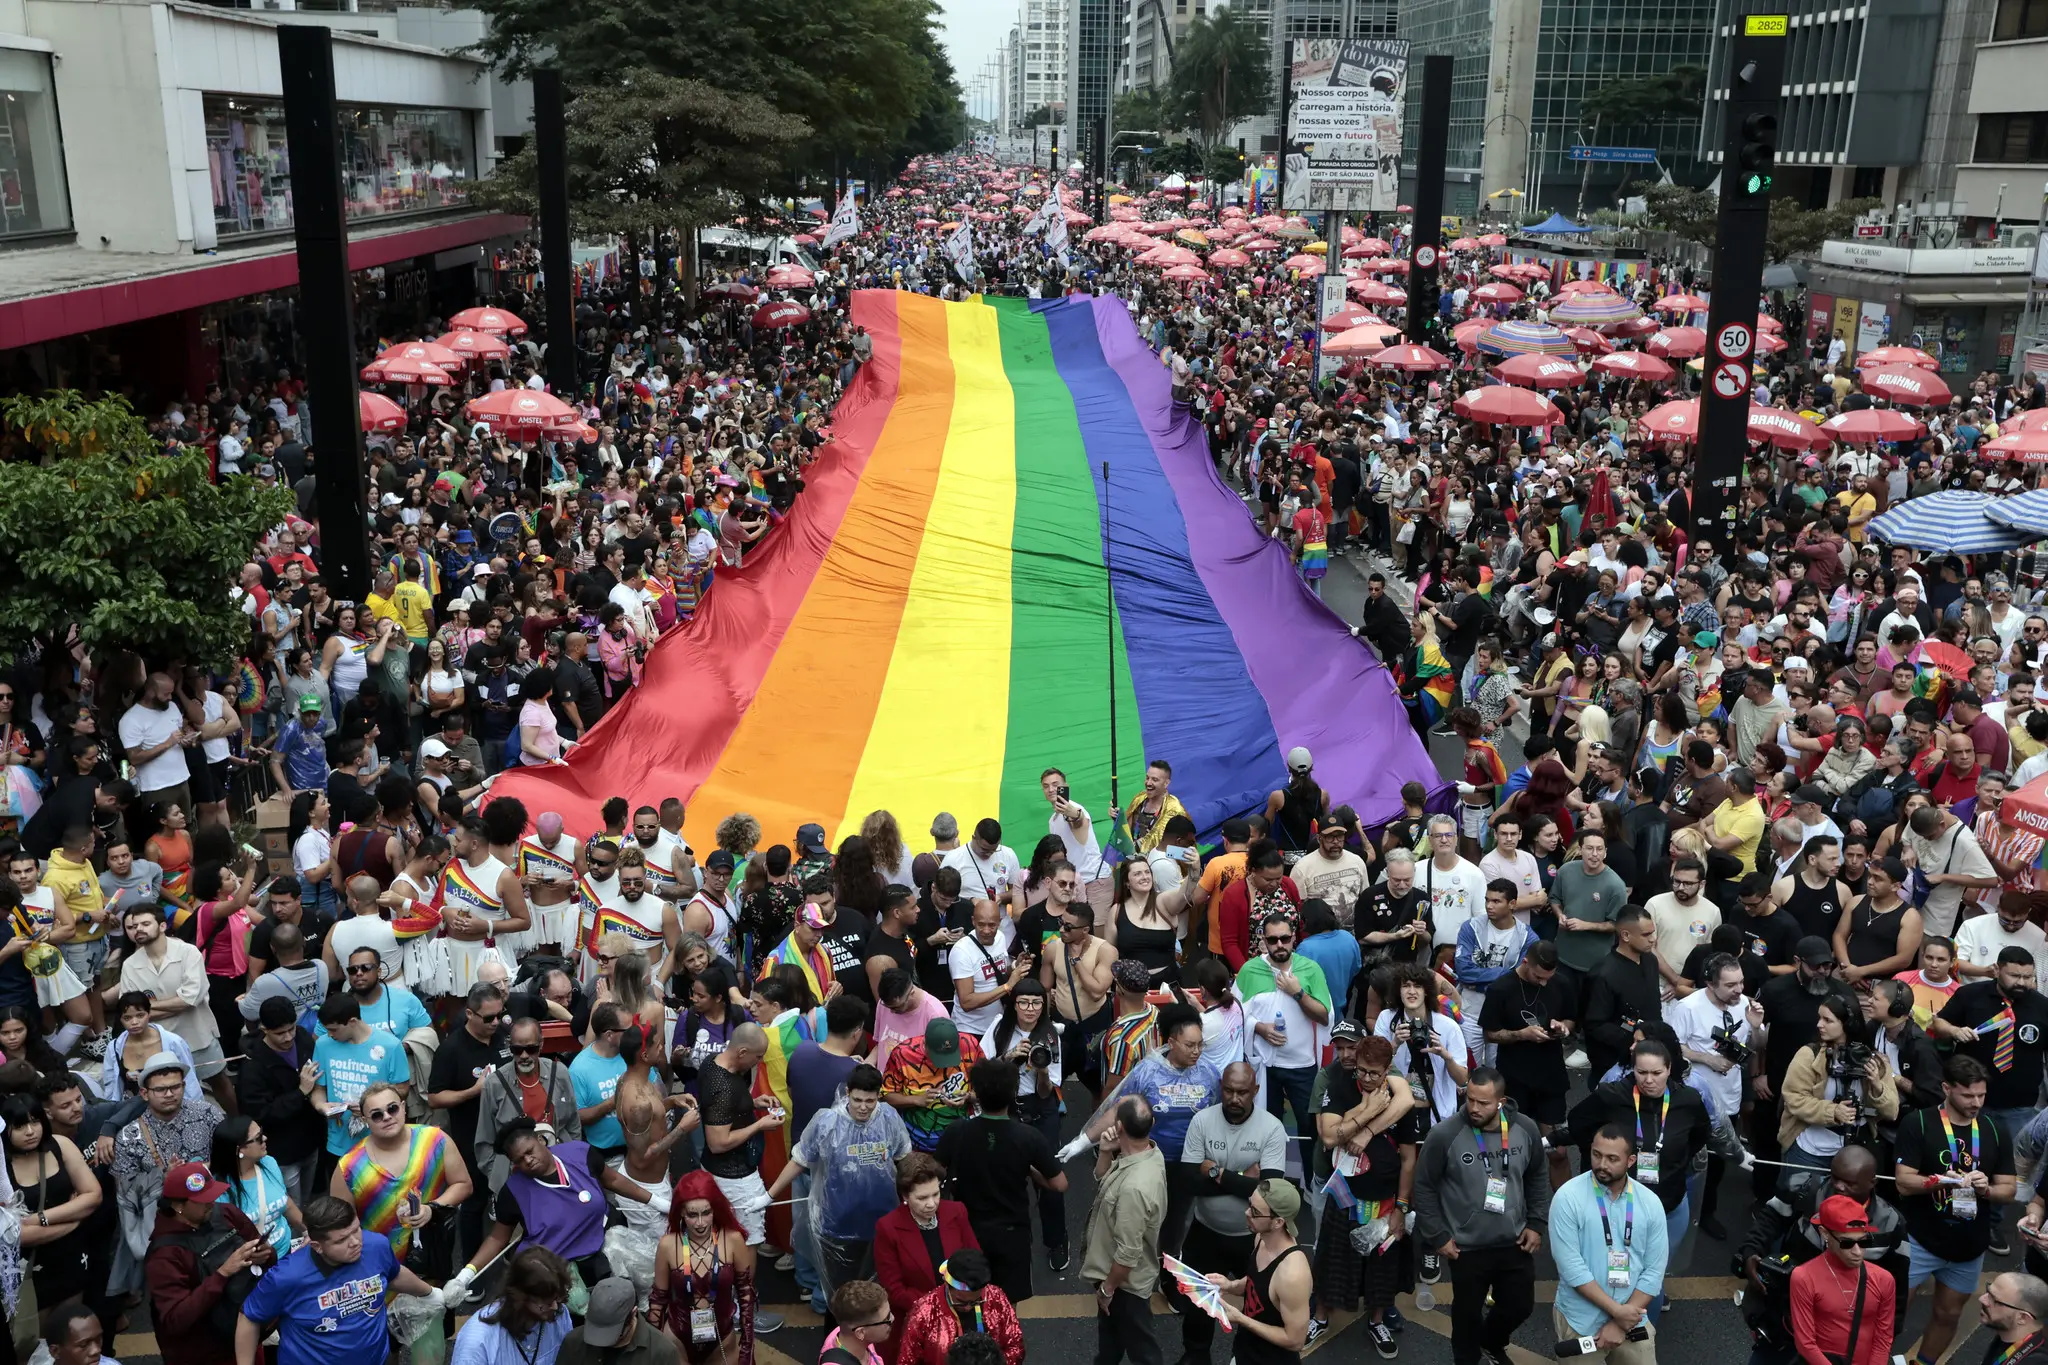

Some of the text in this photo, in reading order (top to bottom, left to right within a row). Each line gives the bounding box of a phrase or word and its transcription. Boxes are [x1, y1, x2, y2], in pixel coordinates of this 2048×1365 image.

[1757, 21, 1783, 31] 2825
[1344, 46, 1361, 60] do
[1336, 90, 1369, 98] corpos
[1356, 103, 1394, 112] história,
[1333, 118, 1360, 126] vozes
[1344, 131, 1373, 140] futuro
[395, 268, 428, 301] marisa
[1723, 331, 1747, 348] 50
[1875, 374, 1922, 393] BRAHMA
[518, 416, 543, 424] AMSTEL
[1749, 414, 1801, 436] BRAHMA
[1659, 432, 1681, 441] AMSTEL
[402, 597, 409, 619] 9
[2013, 808, 2048, 831] AMSTE
[329, 1058, 379, 1074] POLÍTICA&
[1903, 1062, 1911, 1070] P
[1208, 1140, 1226, 1150] 169
